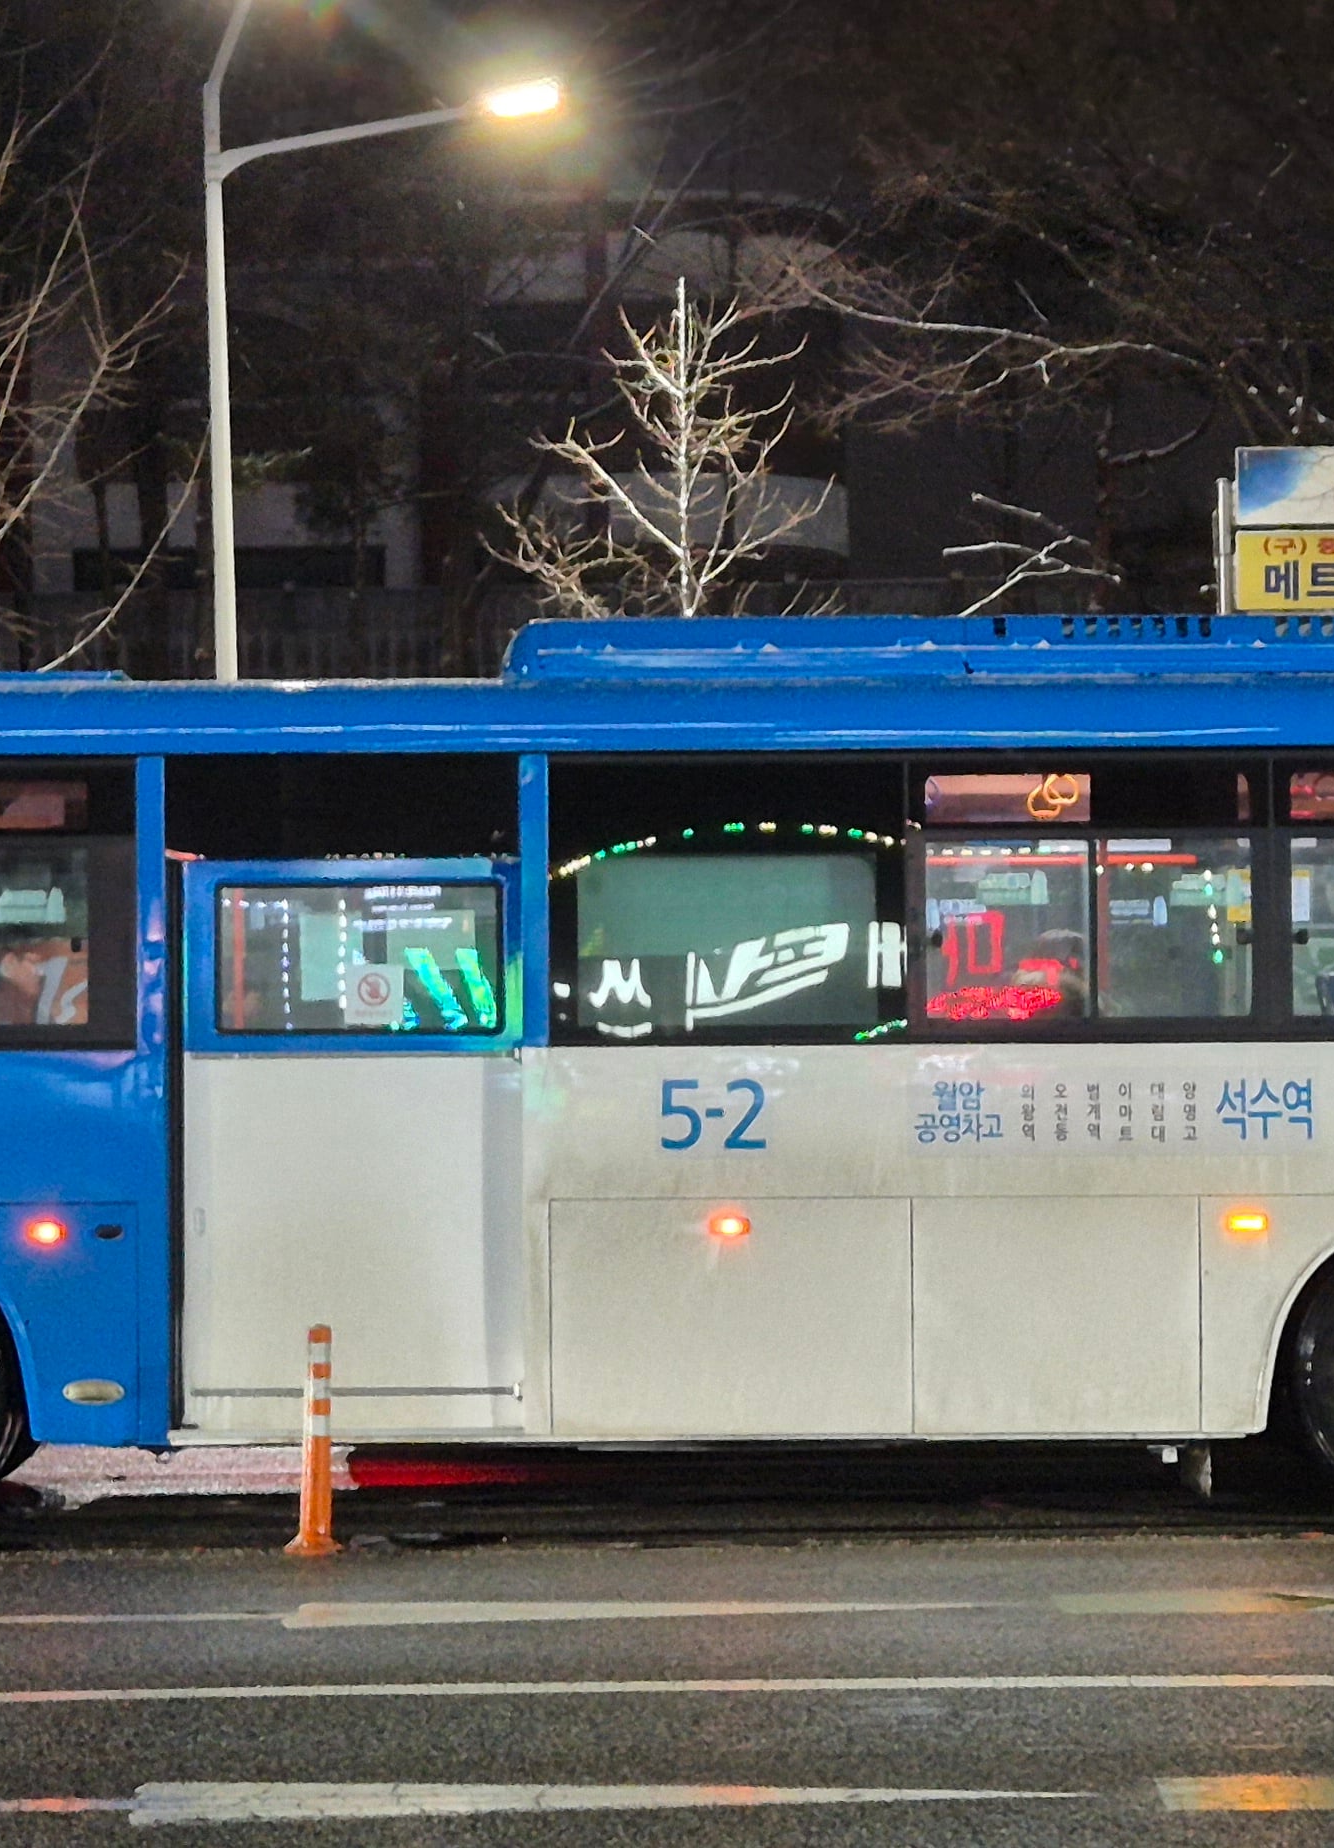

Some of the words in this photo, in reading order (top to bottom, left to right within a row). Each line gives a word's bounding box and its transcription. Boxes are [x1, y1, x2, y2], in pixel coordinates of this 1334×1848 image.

[1262, 535, 1309, 556] (구)
[660, 1078, 767, 1150] 5-2
[931, 1080, 986, 1112] 월암
[1117, 1081, 1134, 1142] 이마트
[1149, 1081, 1166, 1143] 대림대
[1215, 1077, 1314, 1141] 석수역
[913, 1113, 1004, 1143] 공영차고
